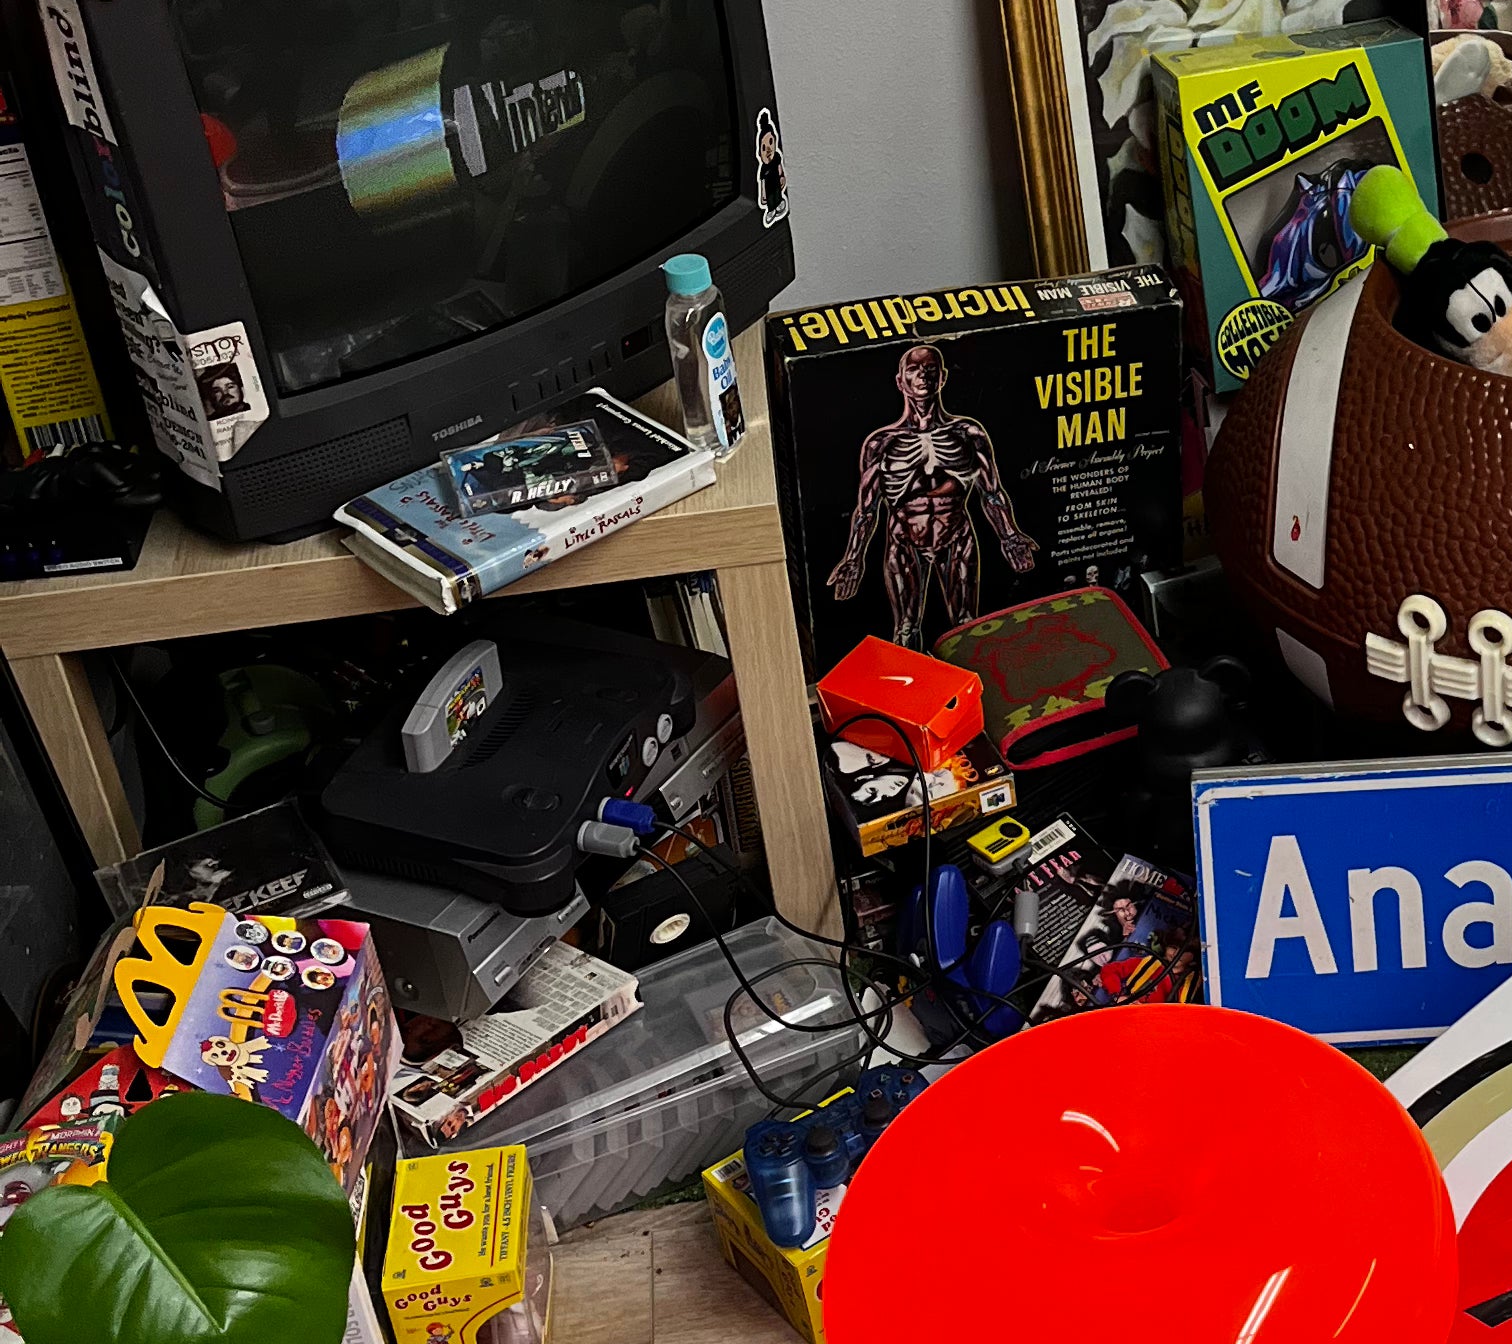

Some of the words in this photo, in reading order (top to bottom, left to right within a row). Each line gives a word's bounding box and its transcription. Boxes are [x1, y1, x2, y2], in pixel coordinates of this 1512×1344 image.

[1193, 79, 1264, 135] MF
[1197, 62, 1372, 192] DOOM
[1078, 278, 1132, 296] VISIBLE
[1132, 273, 1164, 288] THE
[1036, 287, 1073, 301] MAN
[782, 285, 1036, 351] incredible!
[1219, 300, 1294, 352] COLLECTIBLE
[1062, 323, 1117, 362] THE
[1035, 362, 1143, 410] VISIBLE
[432, 413, 484, 443] TOSHIBA
[1057, 407, 1127, 449] MAN
[1128, 443, 1164, 463] Project
[1052, 475, 1068, 486] THE
[1070, 467, 1115, 481] WONDERS
[1117, 465, 1130, 475] OF
[1052, 484, 1068, 494] THE
[1070, 478, 1103, 492] HUMAN
[1106, 474, 1130, 486] BODY
[1065, 501, 1092, 513] FROM
[1096, 497, 1118, 507] SKIN
[1070, 486, 1113, 500] REVEALED!
[1057, 513, 1070, 524] TO
[1050, 547, 1069, 559] Parts
[1070, 538, 1118, 555] undecorated
[1119, 534, 1135, 545] and
[1057, 533, 1085, 545] replace
[1087, 529, 1097, 539] all
[1057, 554, 1081, 566] paints
[1082, 551, 1095, 561] not
[1096, 545, 1128, 559] included
[1120, 858, 1169, 890] HOME
[440, 1160, 476, 1230] Guys
[402, 1202, 453, 1271] Good
[394, 1284, 443, 1311] Good
[422, 1292, 473, 1313] Guys
